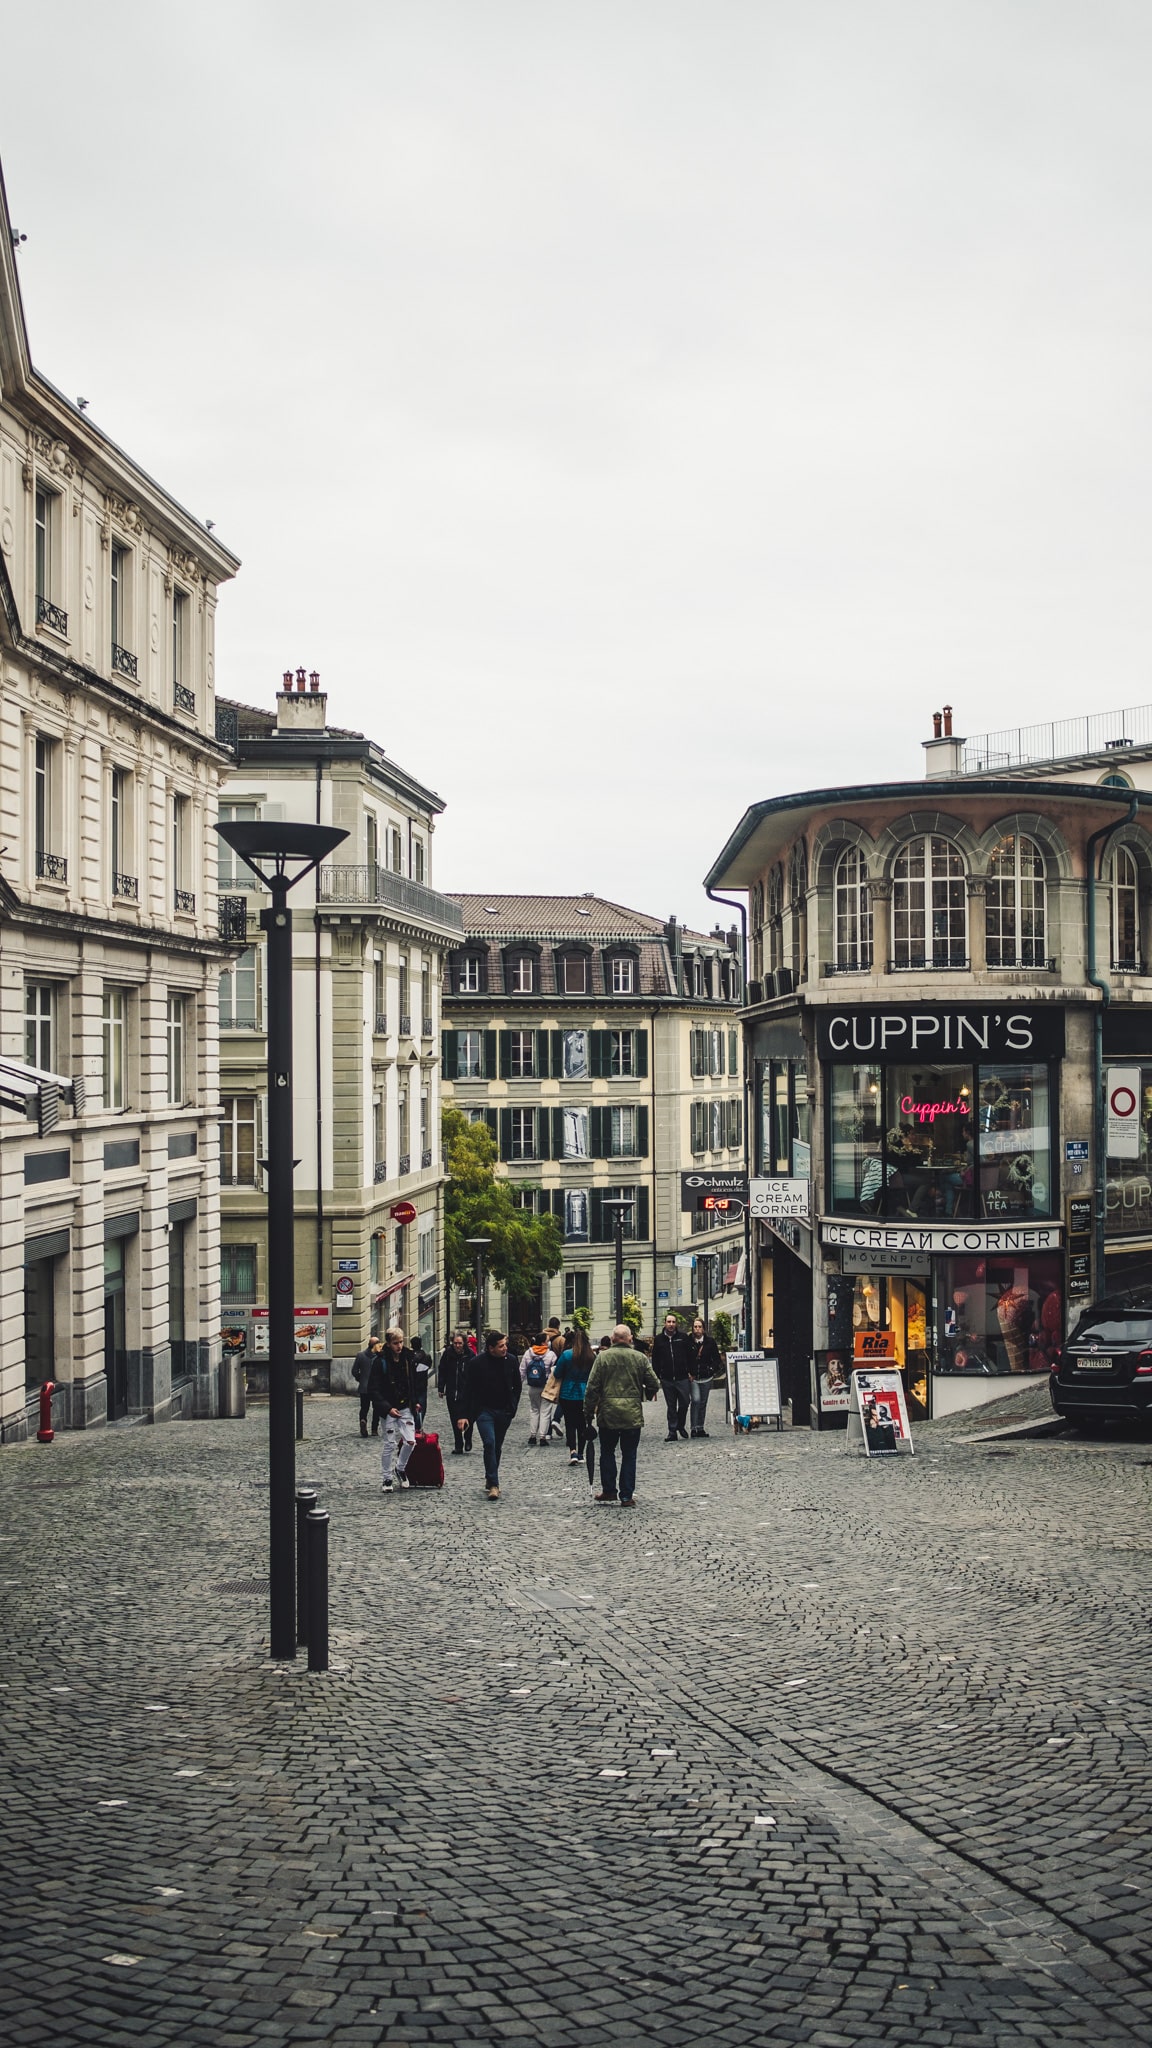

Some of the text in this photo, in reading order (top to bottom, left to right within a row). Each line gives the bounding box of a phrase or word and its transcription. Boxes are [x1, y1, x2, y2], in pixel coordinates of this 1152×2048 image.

[829, 1015, 1033, 1050] CUPPIN'S
[901, 1096, 970, 1123] Cuppin's
[767, 1183, 790, 1191] ICE
[756, 1194, 803, 1203] CREAM
[751, 1205, 808, 1214] CORNER
[986, 1201, 1007, 1210] TEA
[826, 1226, 848, 1244] ICE
[942, 1231, 1051, 1250] CORNER
[862, 1333, 889, 1348] Ria
